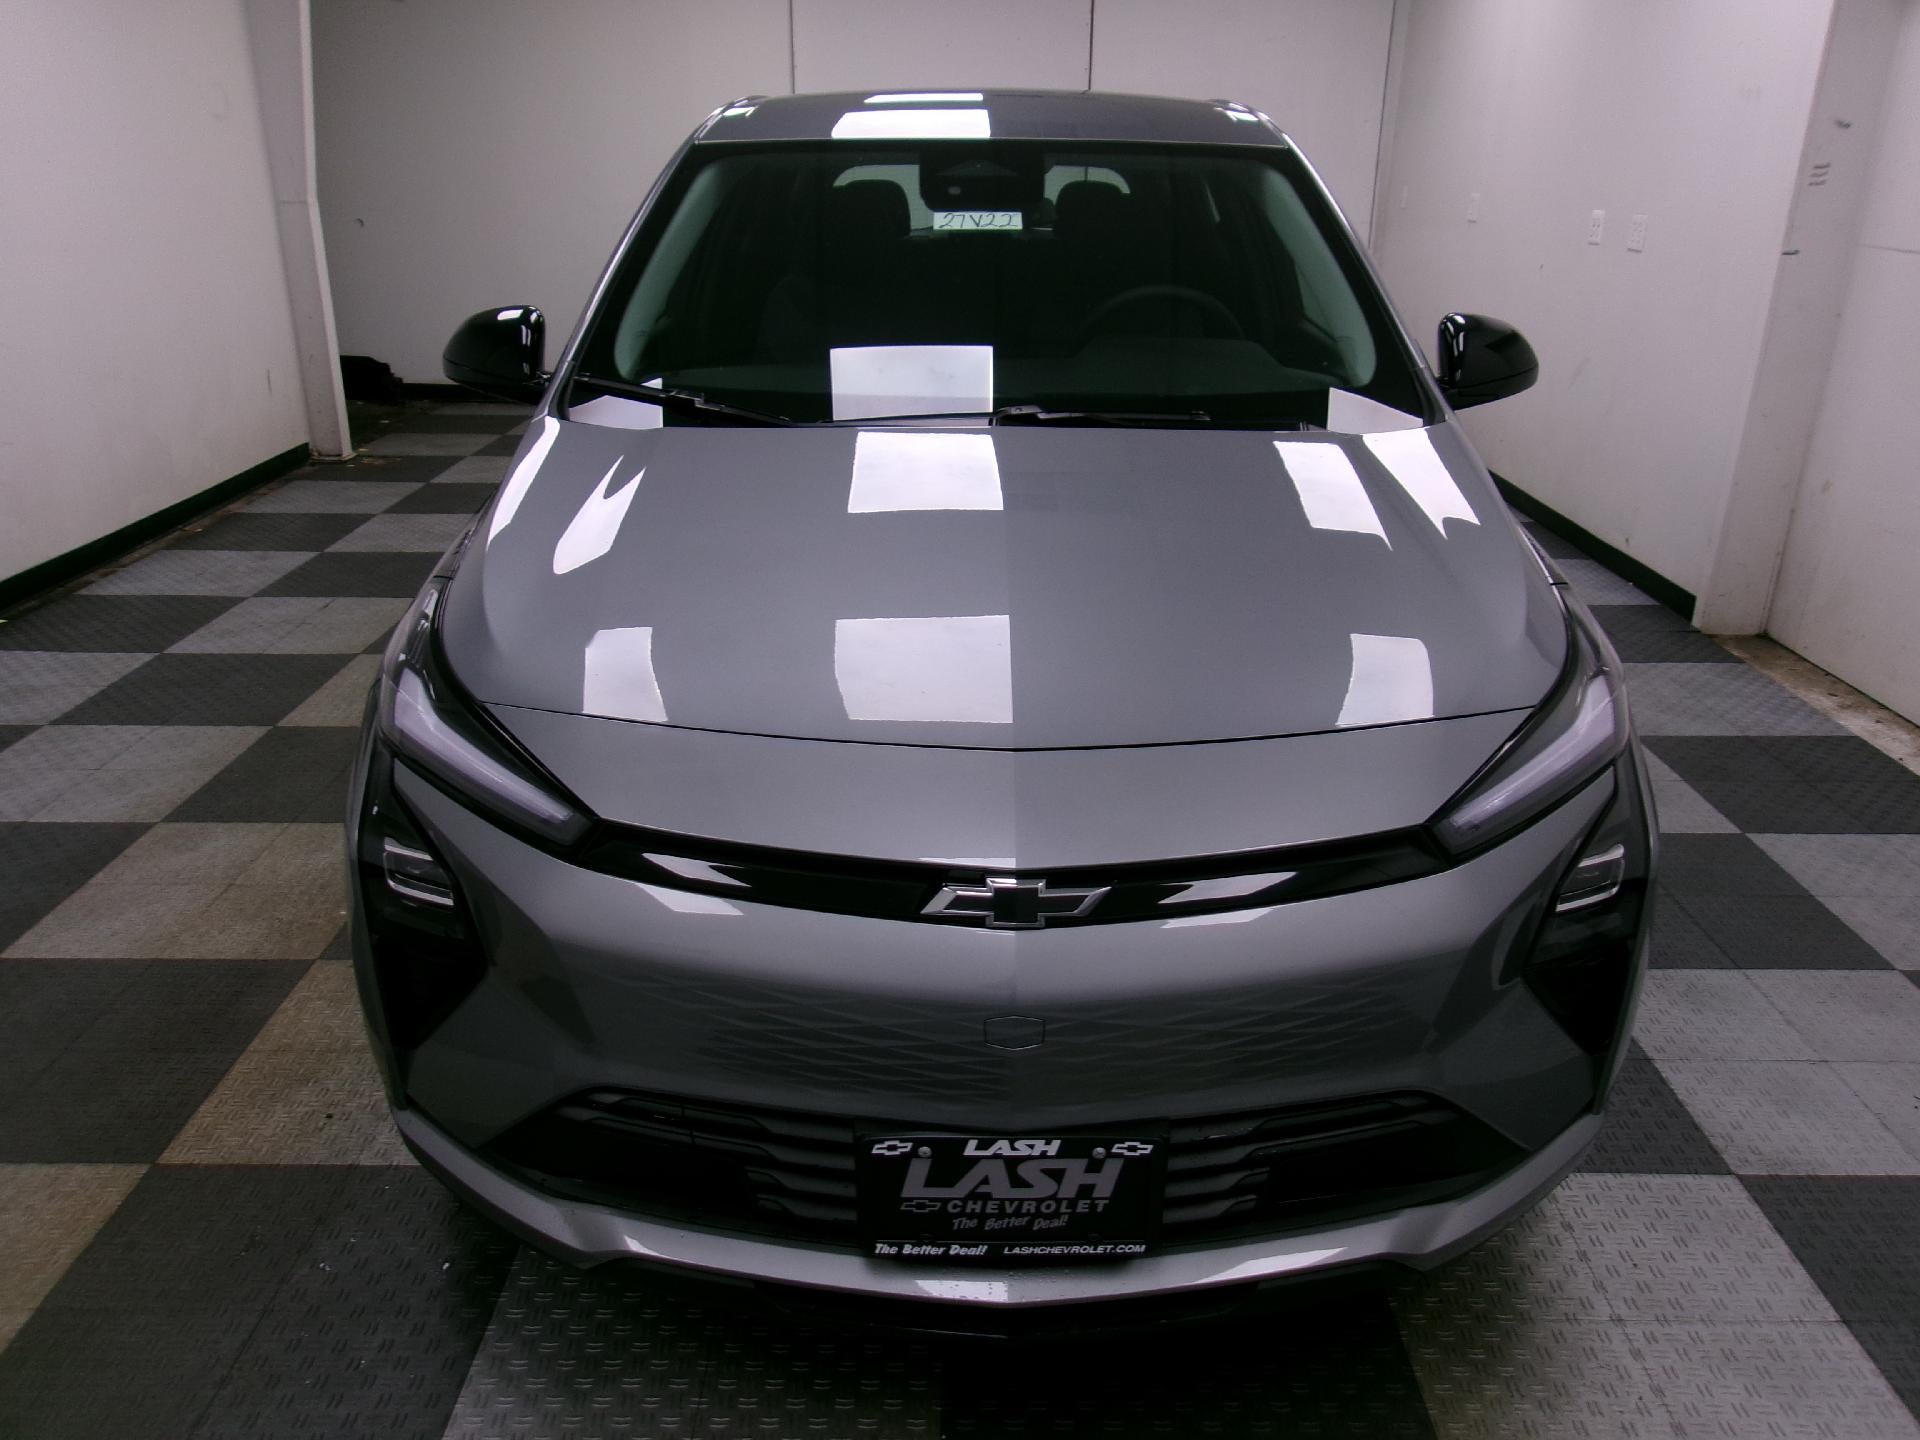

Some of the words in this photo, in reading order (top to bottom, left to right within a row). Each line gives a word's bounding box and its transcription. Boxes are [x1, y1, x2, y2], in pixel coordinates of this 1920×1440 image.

[963, 1139, 1061, 1156] LASH
[901, 1158, 1124, 1199] LASH
[946, 1199, 1110, 1214] CHEVROLET
[952, 1216, 978, 1230] The
[984, 1216, 1029, 1230] Better
[1033, 1214, 1069, 1230] Deal!
[874, 1243, 899, 1254] The
[902, 1243, 946, 1255] Better
[949, 1244, 988, 1256] Deal!
[1003, 1243, 1146, 1255] LASHCHEVROLET.COM
